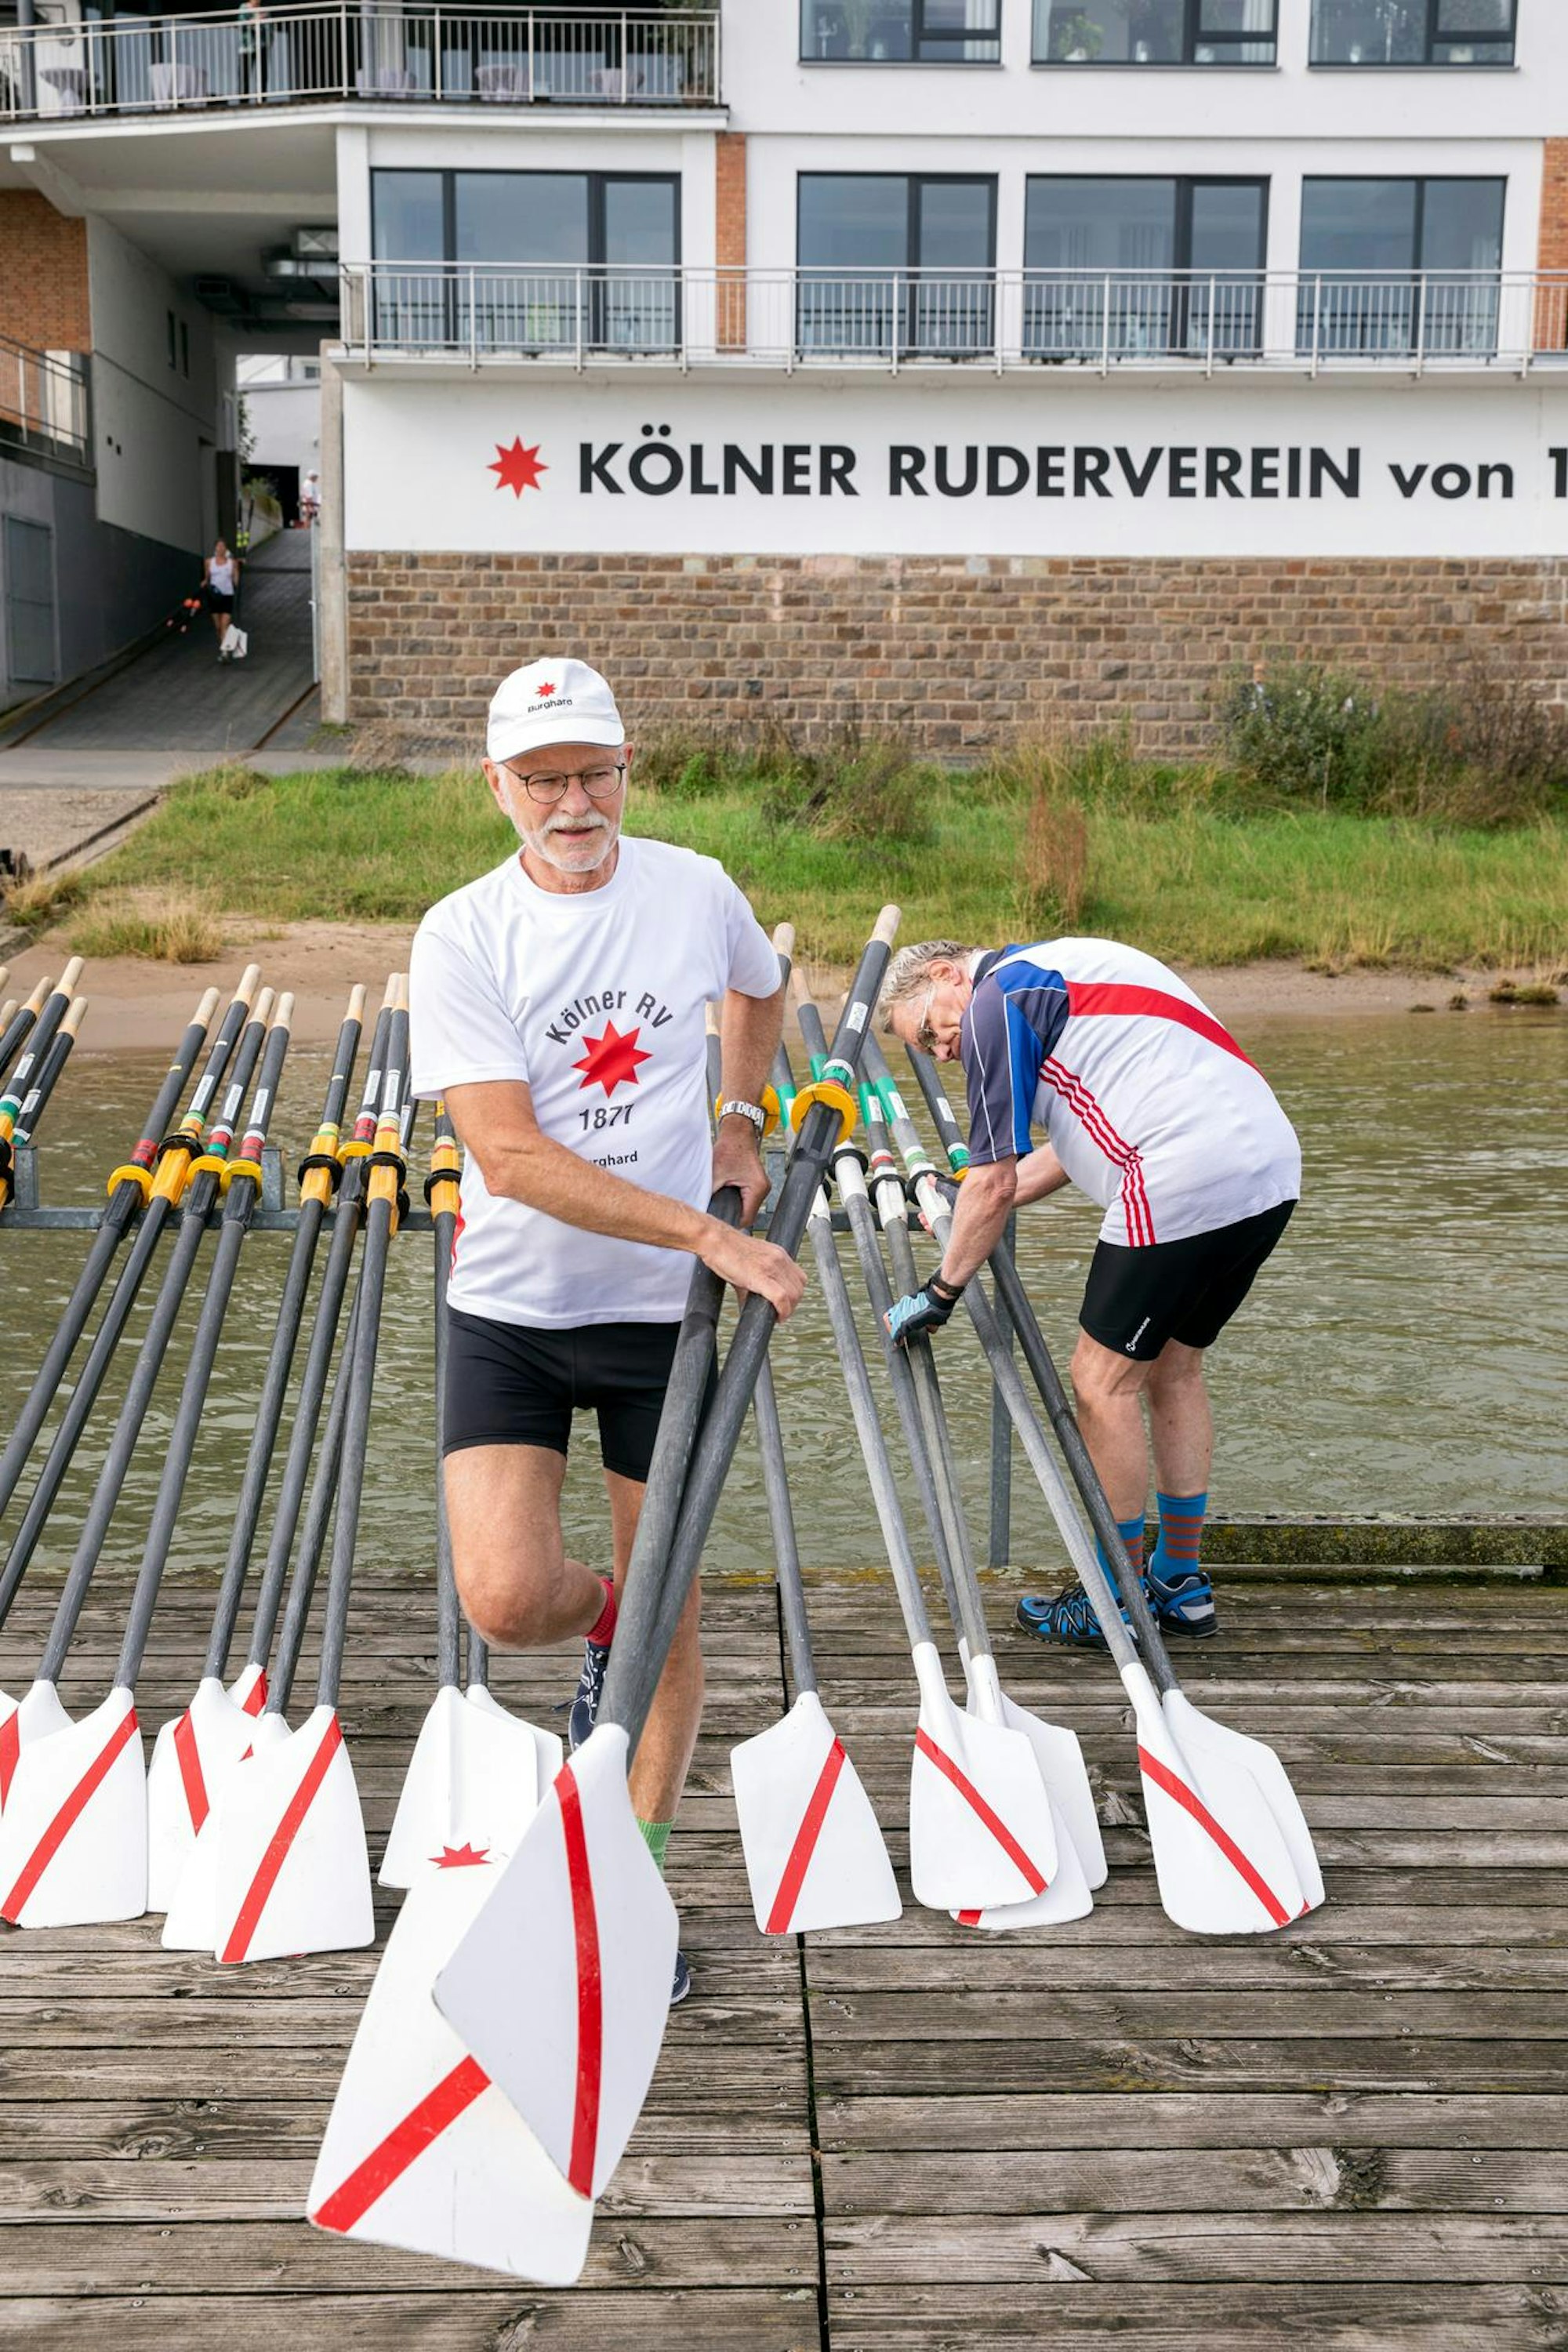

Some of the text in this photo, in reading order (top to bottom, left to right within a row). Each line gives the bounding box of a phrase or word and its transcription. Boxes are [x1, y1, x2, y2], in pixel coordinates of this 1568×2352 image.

[581, 424, 858, 495] KÖLNER
[889, 445, 1360, 498] RUDERVEREIN
[1388, 463, 1513, 499] von
[545, 989, 673, 1045] Kölner RV
